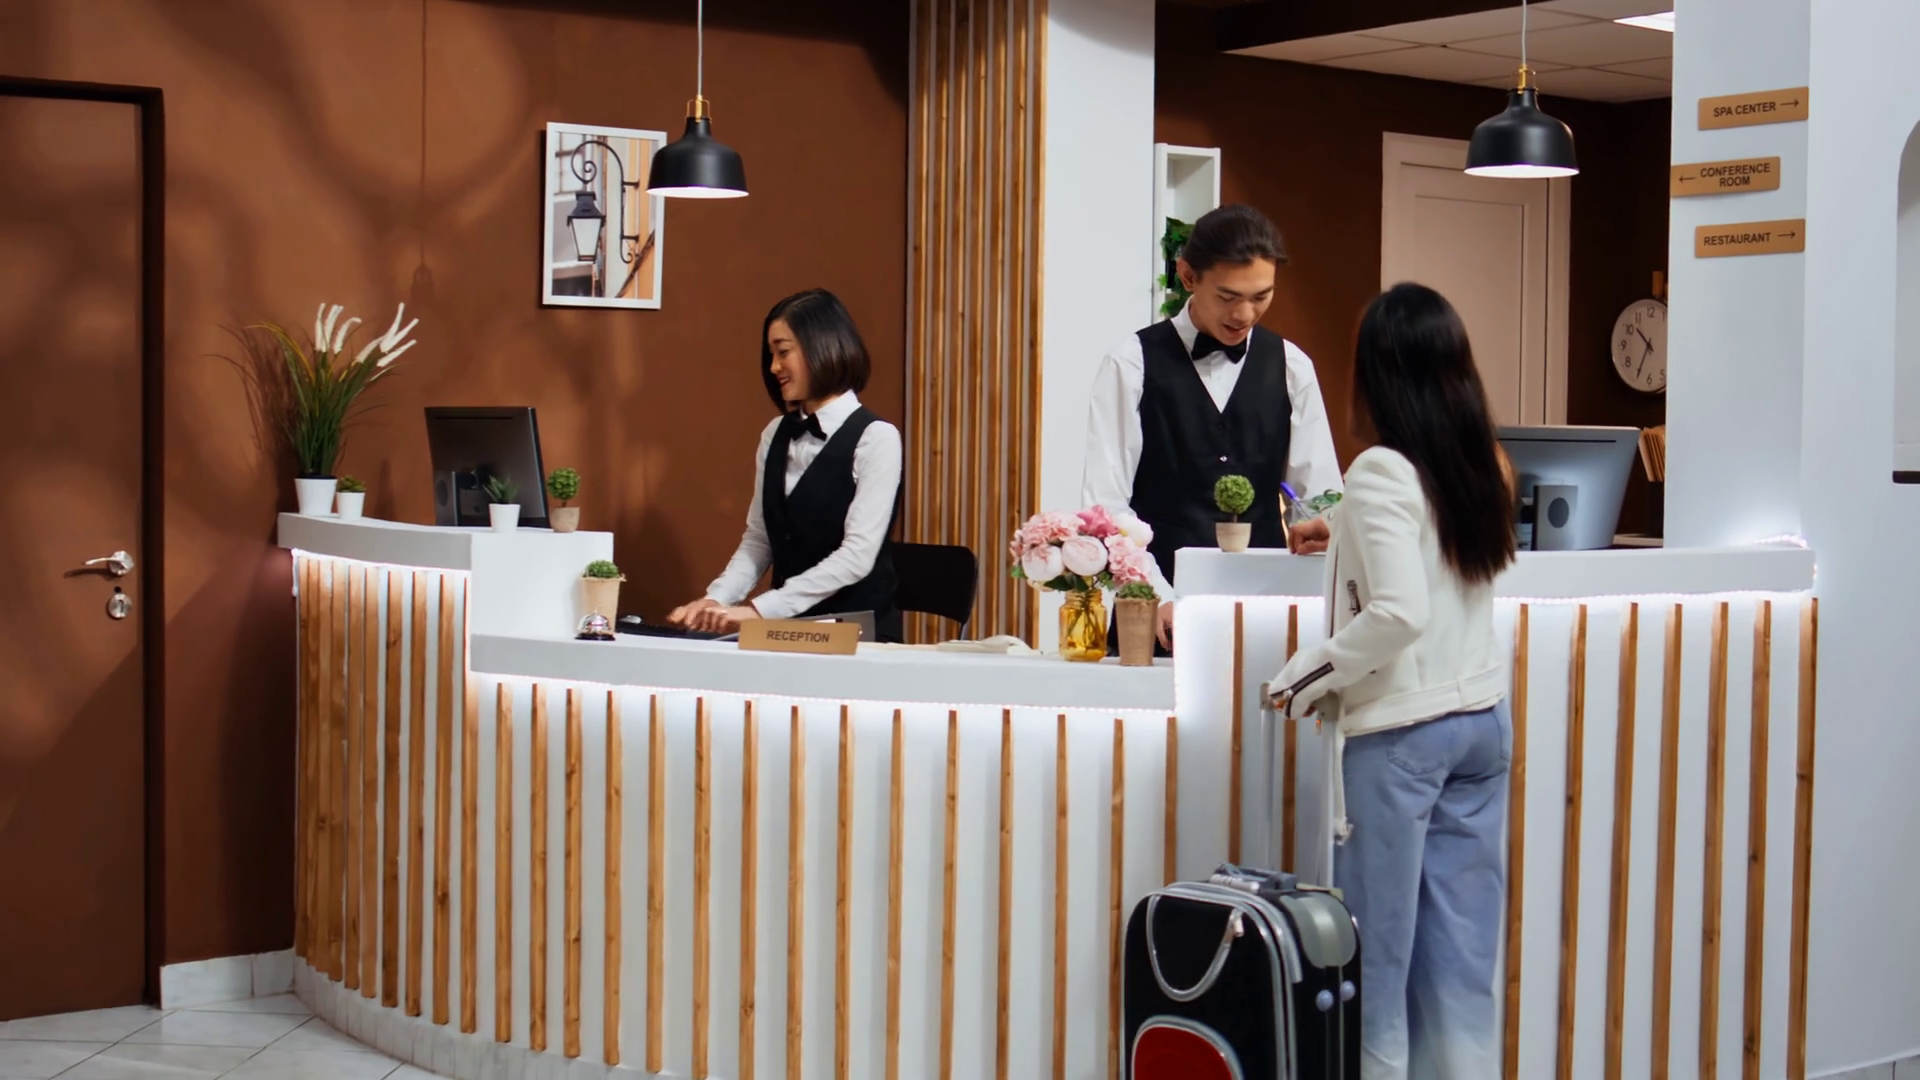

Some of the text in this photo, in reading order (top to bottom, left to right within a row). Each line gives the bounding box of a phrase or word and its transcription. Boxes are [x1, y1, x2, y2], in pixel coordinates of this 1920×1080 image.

[1713, 101, 1776, 117] SPA CENTER
[1700, 162, 1770, 178] CONFERENCE
[1719, 175, 1750, 187] ROOM
[1703, 232, 1771, 246] RESTAURANT
[1647, 306, 1655, 318] 12
[1626, 324, 1634, 335] 10
[1621, 340, 1627, 351] 9
[1625, 356, 1631, 367] 8
[1646, 373, 1653, 384] 6
[766, 630, 830, 643] RECEPTION
